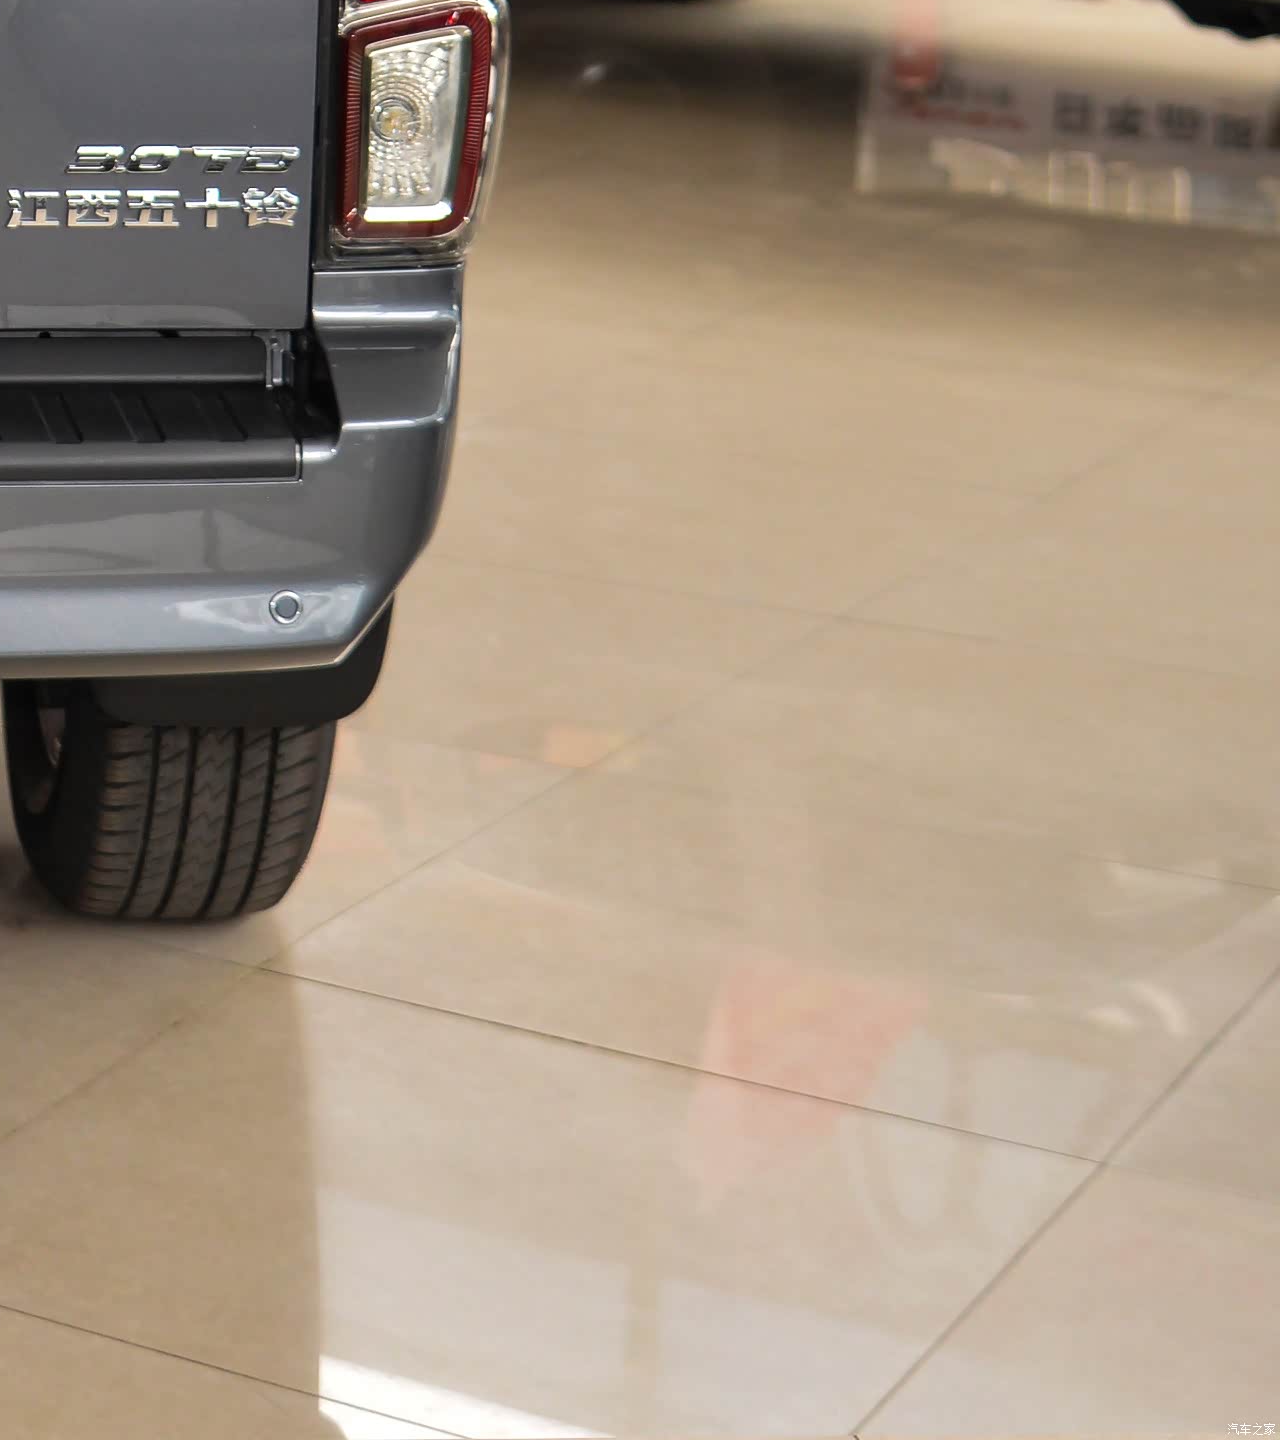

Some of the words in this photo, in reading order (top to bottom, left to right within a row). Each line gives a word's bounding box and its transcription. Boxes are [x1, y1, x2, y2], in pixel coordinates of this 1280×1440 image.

[5, 186, 301, 229] 江西五十铃
